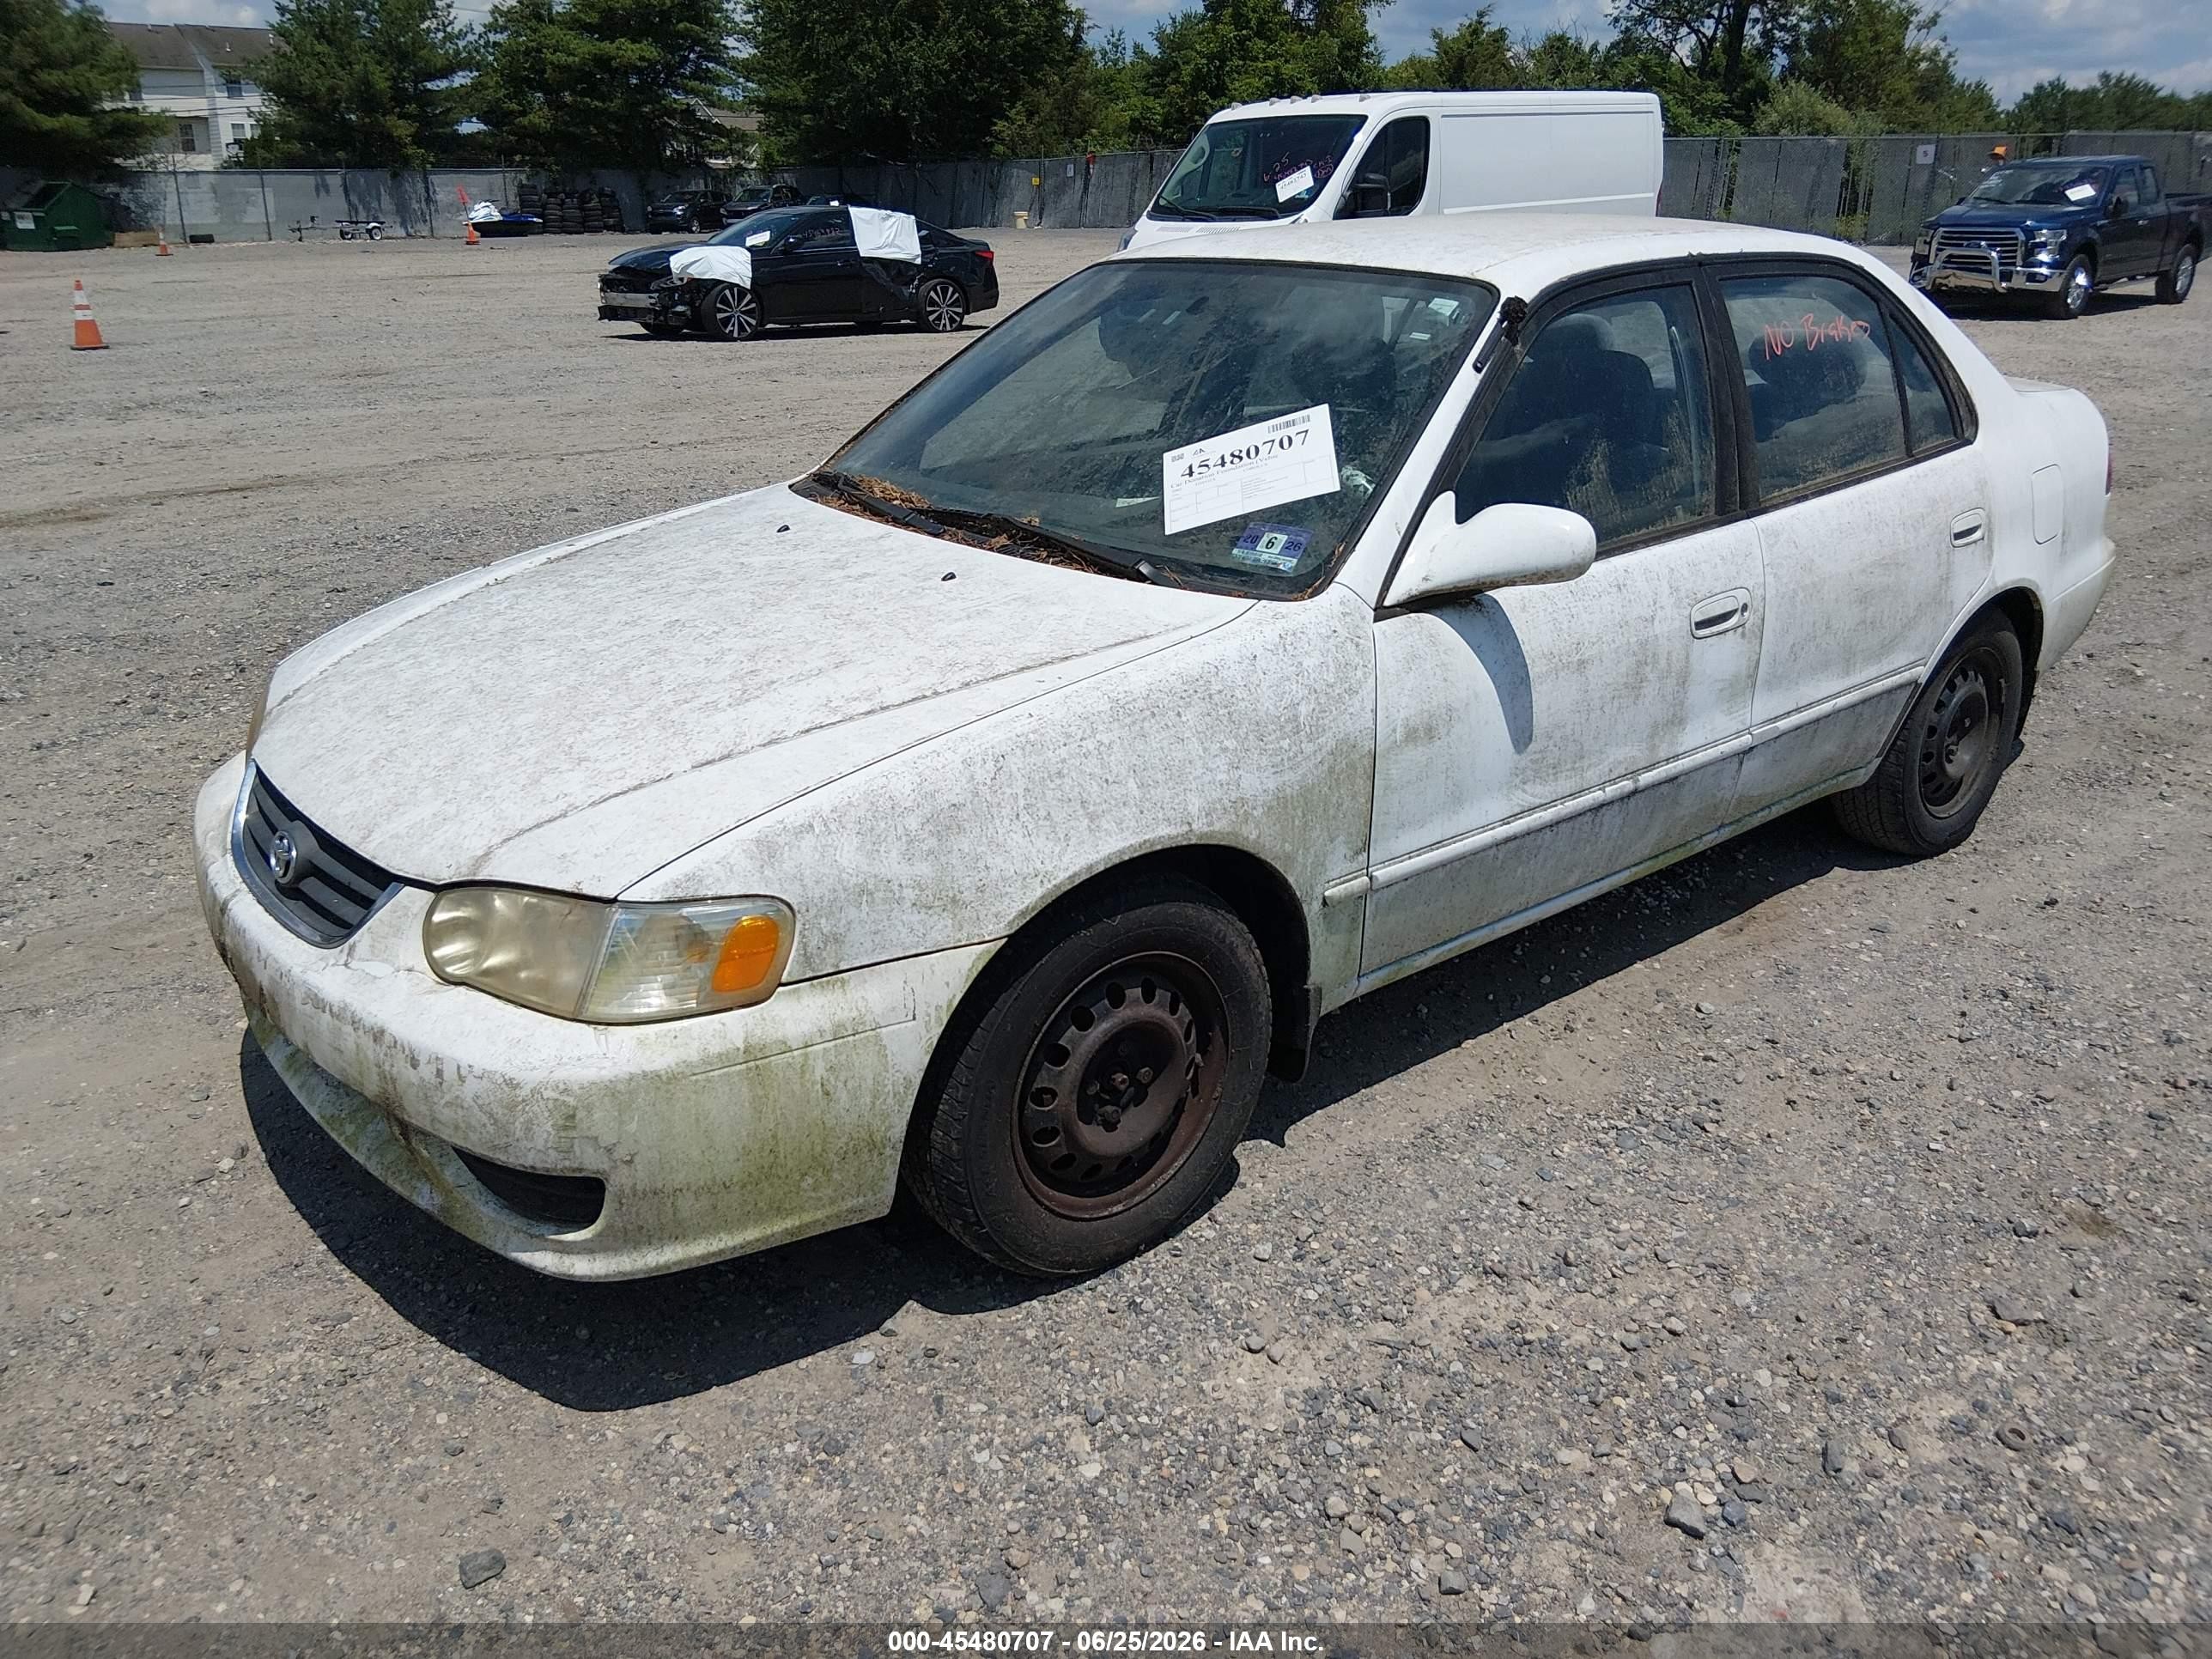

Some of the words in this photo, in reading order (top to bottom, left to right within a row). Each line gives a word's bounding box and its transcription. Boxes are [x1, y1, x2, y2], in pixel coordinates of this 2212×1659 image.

[1181, 429, 1310, 478] 45480707
[1243, 534, 1259, 544] 20
[1265, 536, 1278, 550] 6
[1285, 541, 1302, 551] 26
